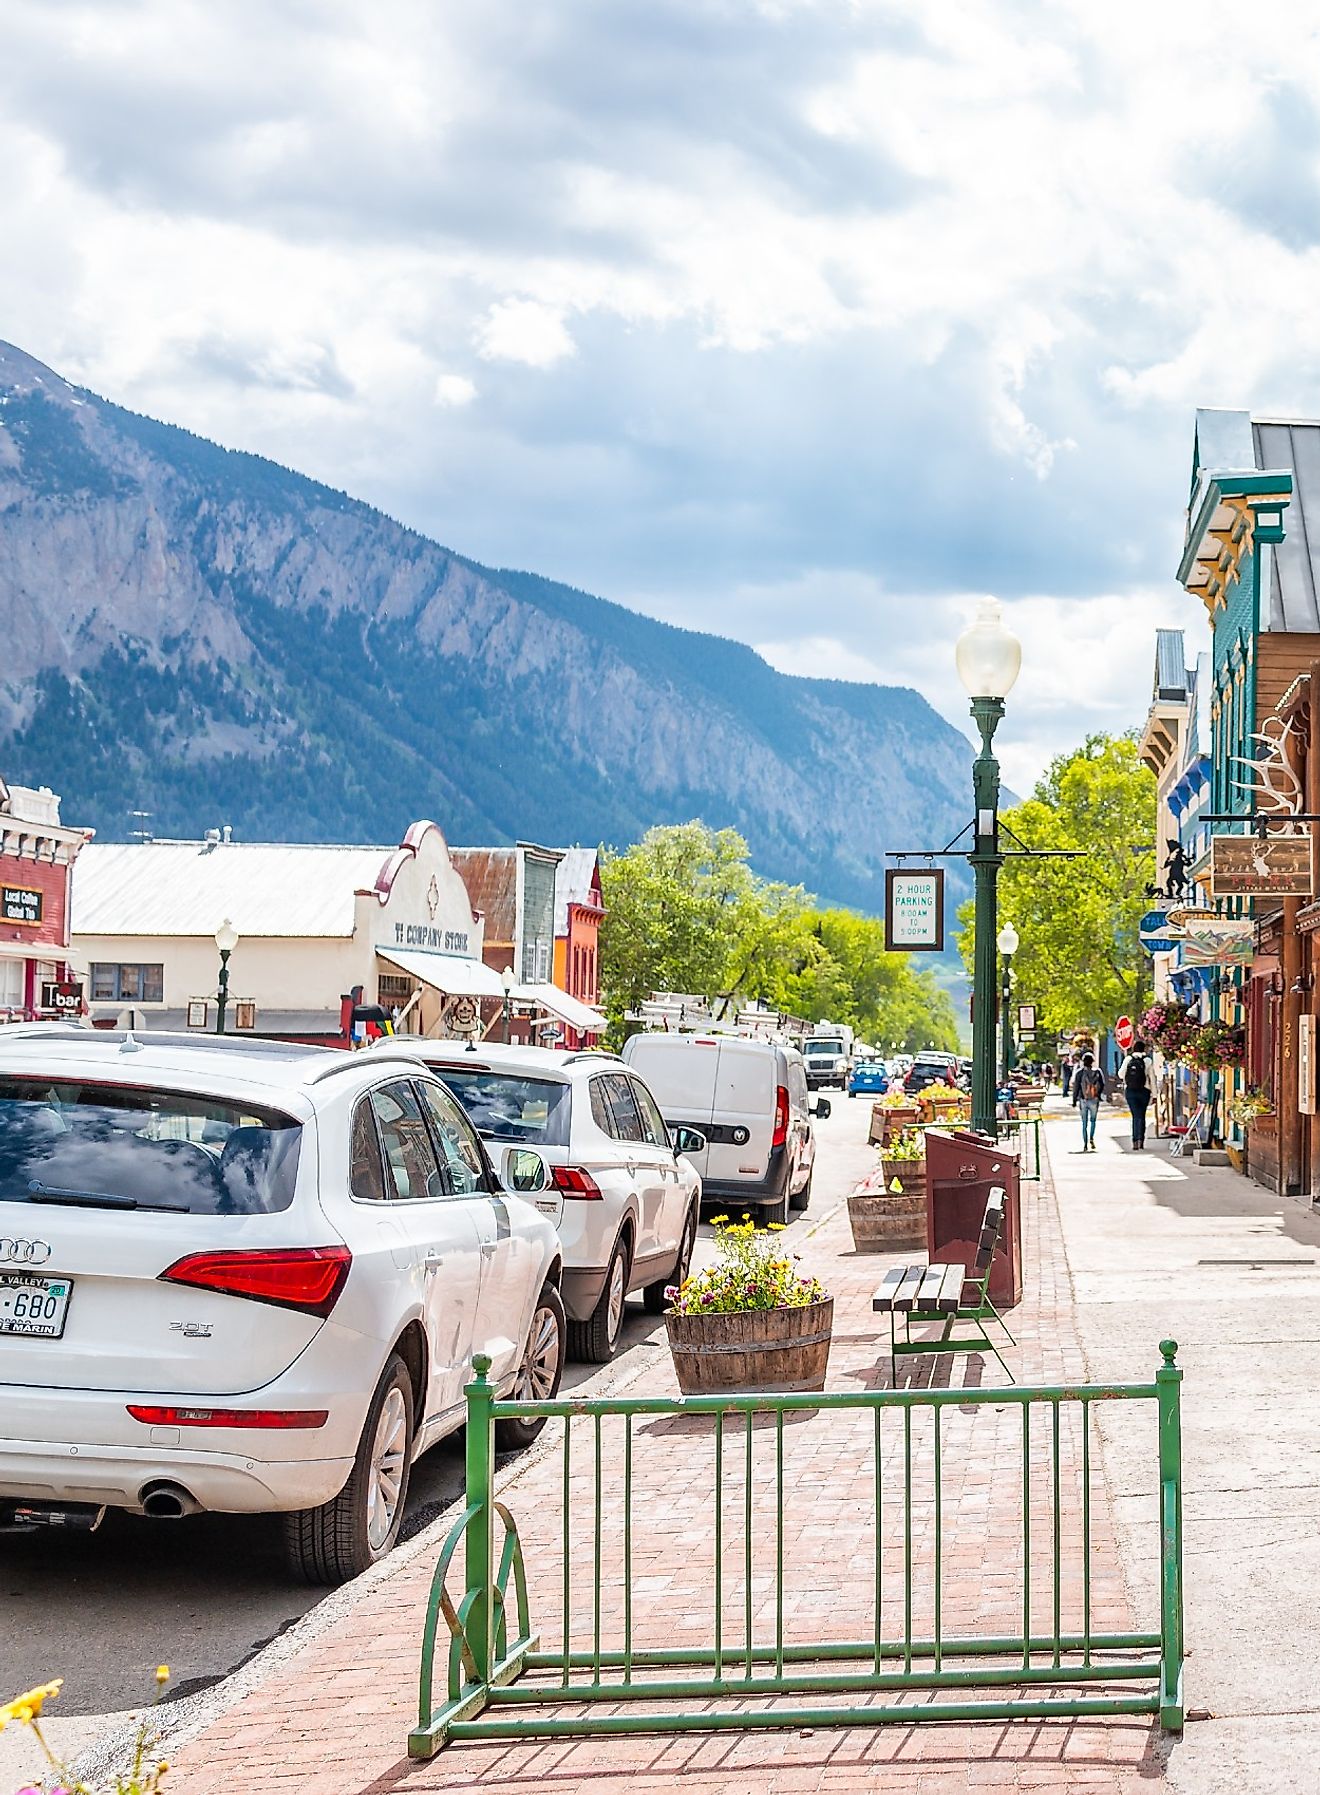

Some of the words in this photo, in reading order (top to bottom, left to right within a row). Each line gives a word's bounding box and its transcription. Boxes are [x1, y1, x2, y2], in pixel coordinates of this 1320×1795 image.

[897, 885, 902, 894] 2
[908, 885, 931, 894] HOUR
[895, 897, 933, 906] PARKING
[407, 925, 442, 948] COMPANY
[445, 931, 468, 951] STORE
[8, 1276, 43, 1286] VALLEY
[13, 1323, 53, 1334] MARIN
